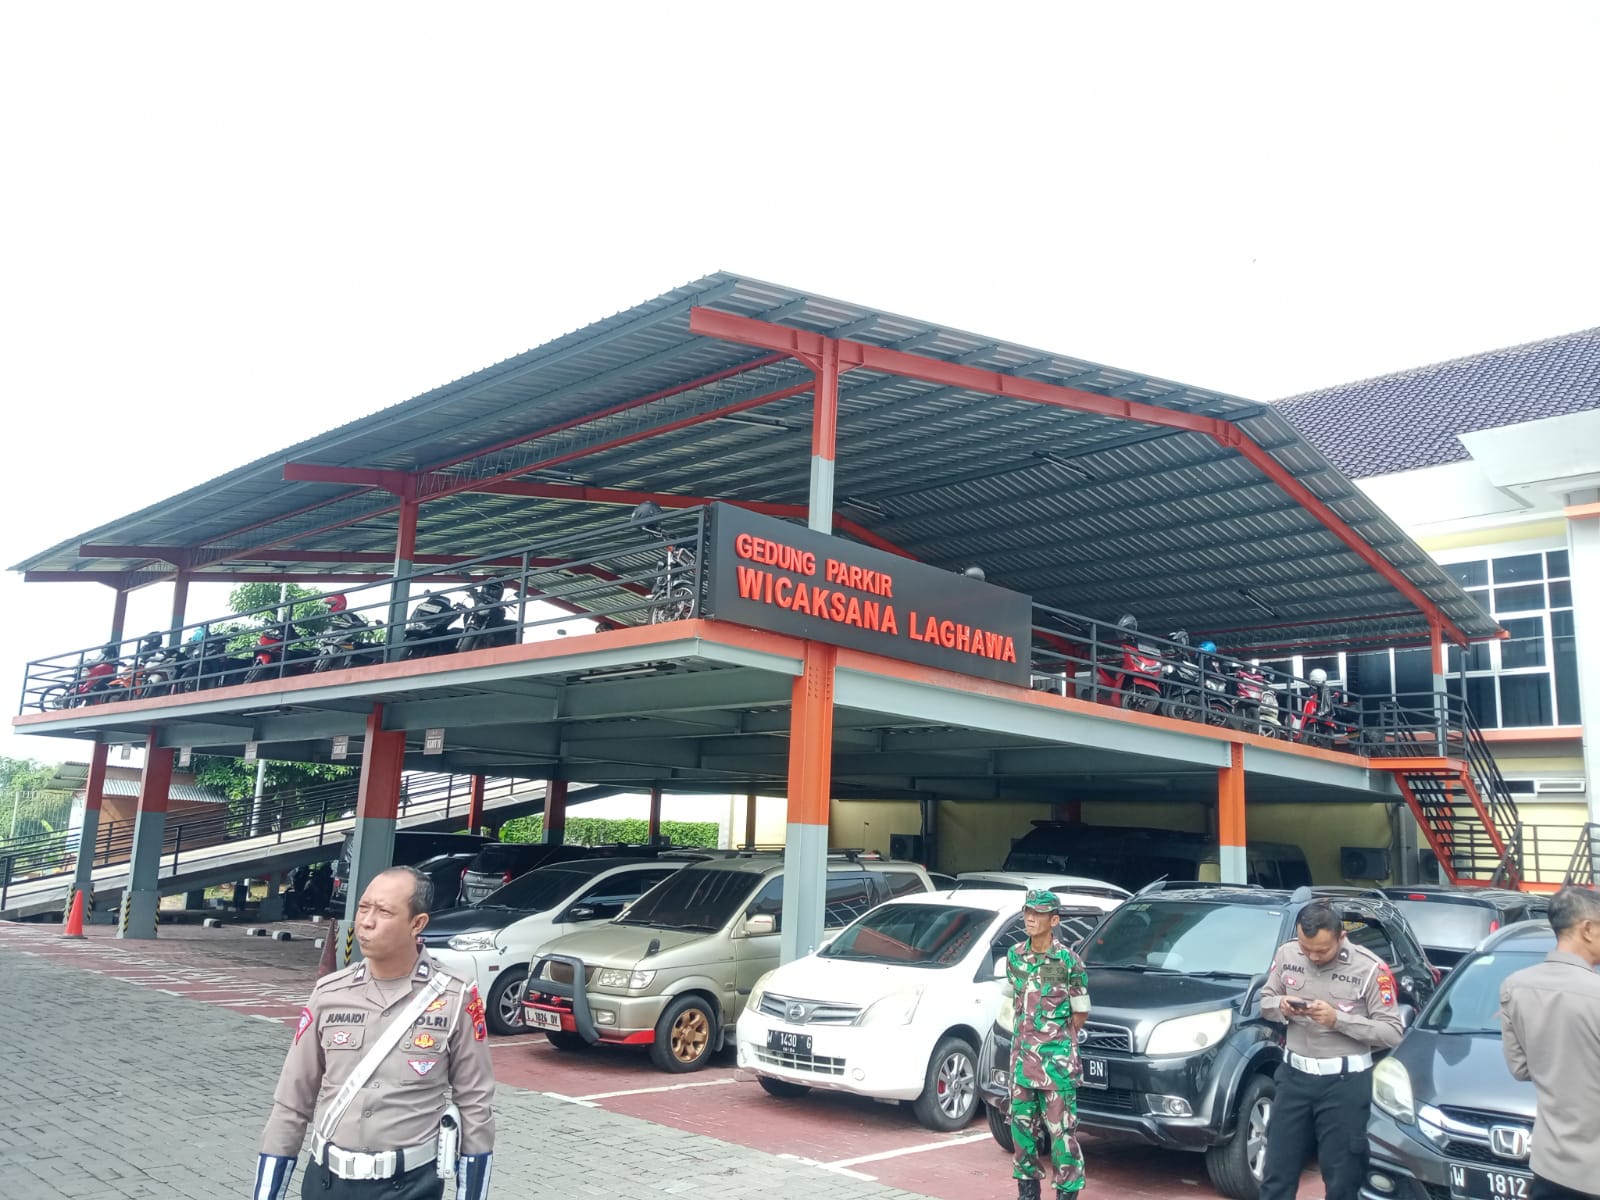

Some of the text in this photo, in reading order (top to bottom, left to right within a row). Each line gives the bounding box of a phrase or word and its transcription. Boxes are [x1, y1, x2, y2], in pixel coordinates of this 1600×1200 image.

[735, 533, 893, 598] GEDUNG PARKIR
[736, 566, 1017, 663] WICAKSANA LAGHAWA
[1331, 973, 1361, 985] POLRI
[325, 1012, 366, 1024] JUNAIDI
[414, 1015, 448, 1027] OLRI
[781, 1032, 798, 1048] 1430
[1089, 1060, 1104, 1077] BN
[1452, 1166, 1528, 1198] W 1812
